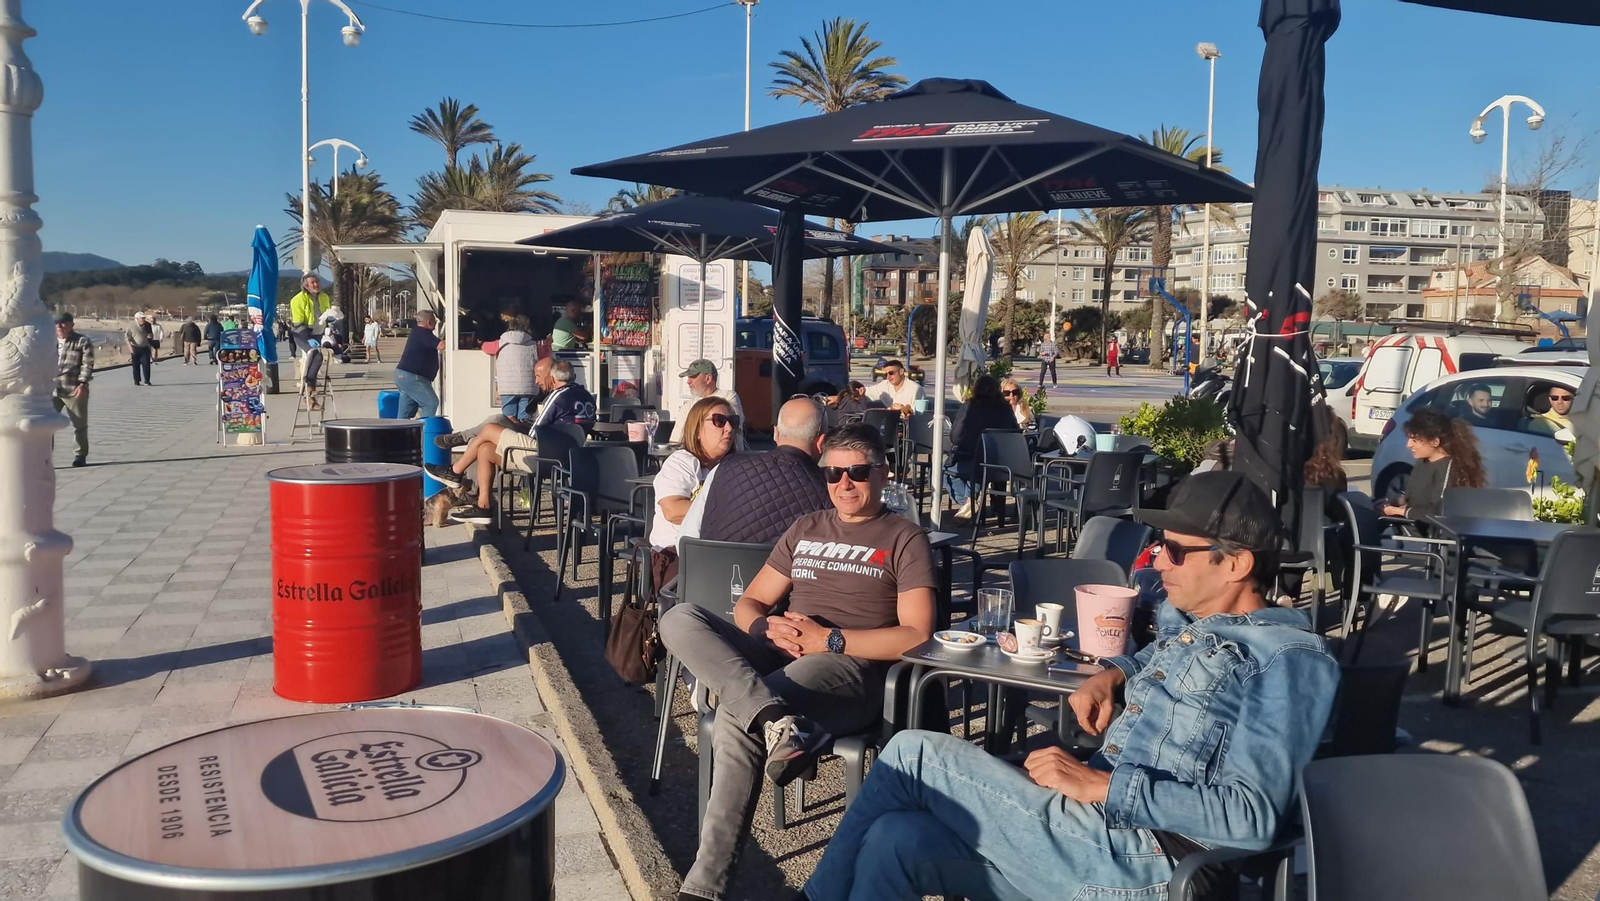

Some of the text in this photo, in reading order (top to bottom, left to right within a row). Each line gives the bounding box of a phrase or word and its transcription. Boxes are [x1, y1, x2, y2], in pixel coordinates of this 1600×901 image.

[858, 125, 948, 139] 1906
[1049, 190, 1110, 201] MILNUEVE
[774, 321, 792, 344] PARA
[793, 540, 891, 567] FANATIK
[791, 568, 818, 580] TORIL
[826, 561, 885, 579] COMMUNITY
[277, 575, 414, 602] Estrella Galic
[310, 749, 375, 806] Galicia
[359, 741, 426, 801] Estrella
[157, 765, 185, 839] DESDE 1906
[198, 755, 232, 838] RESISTENCIA
